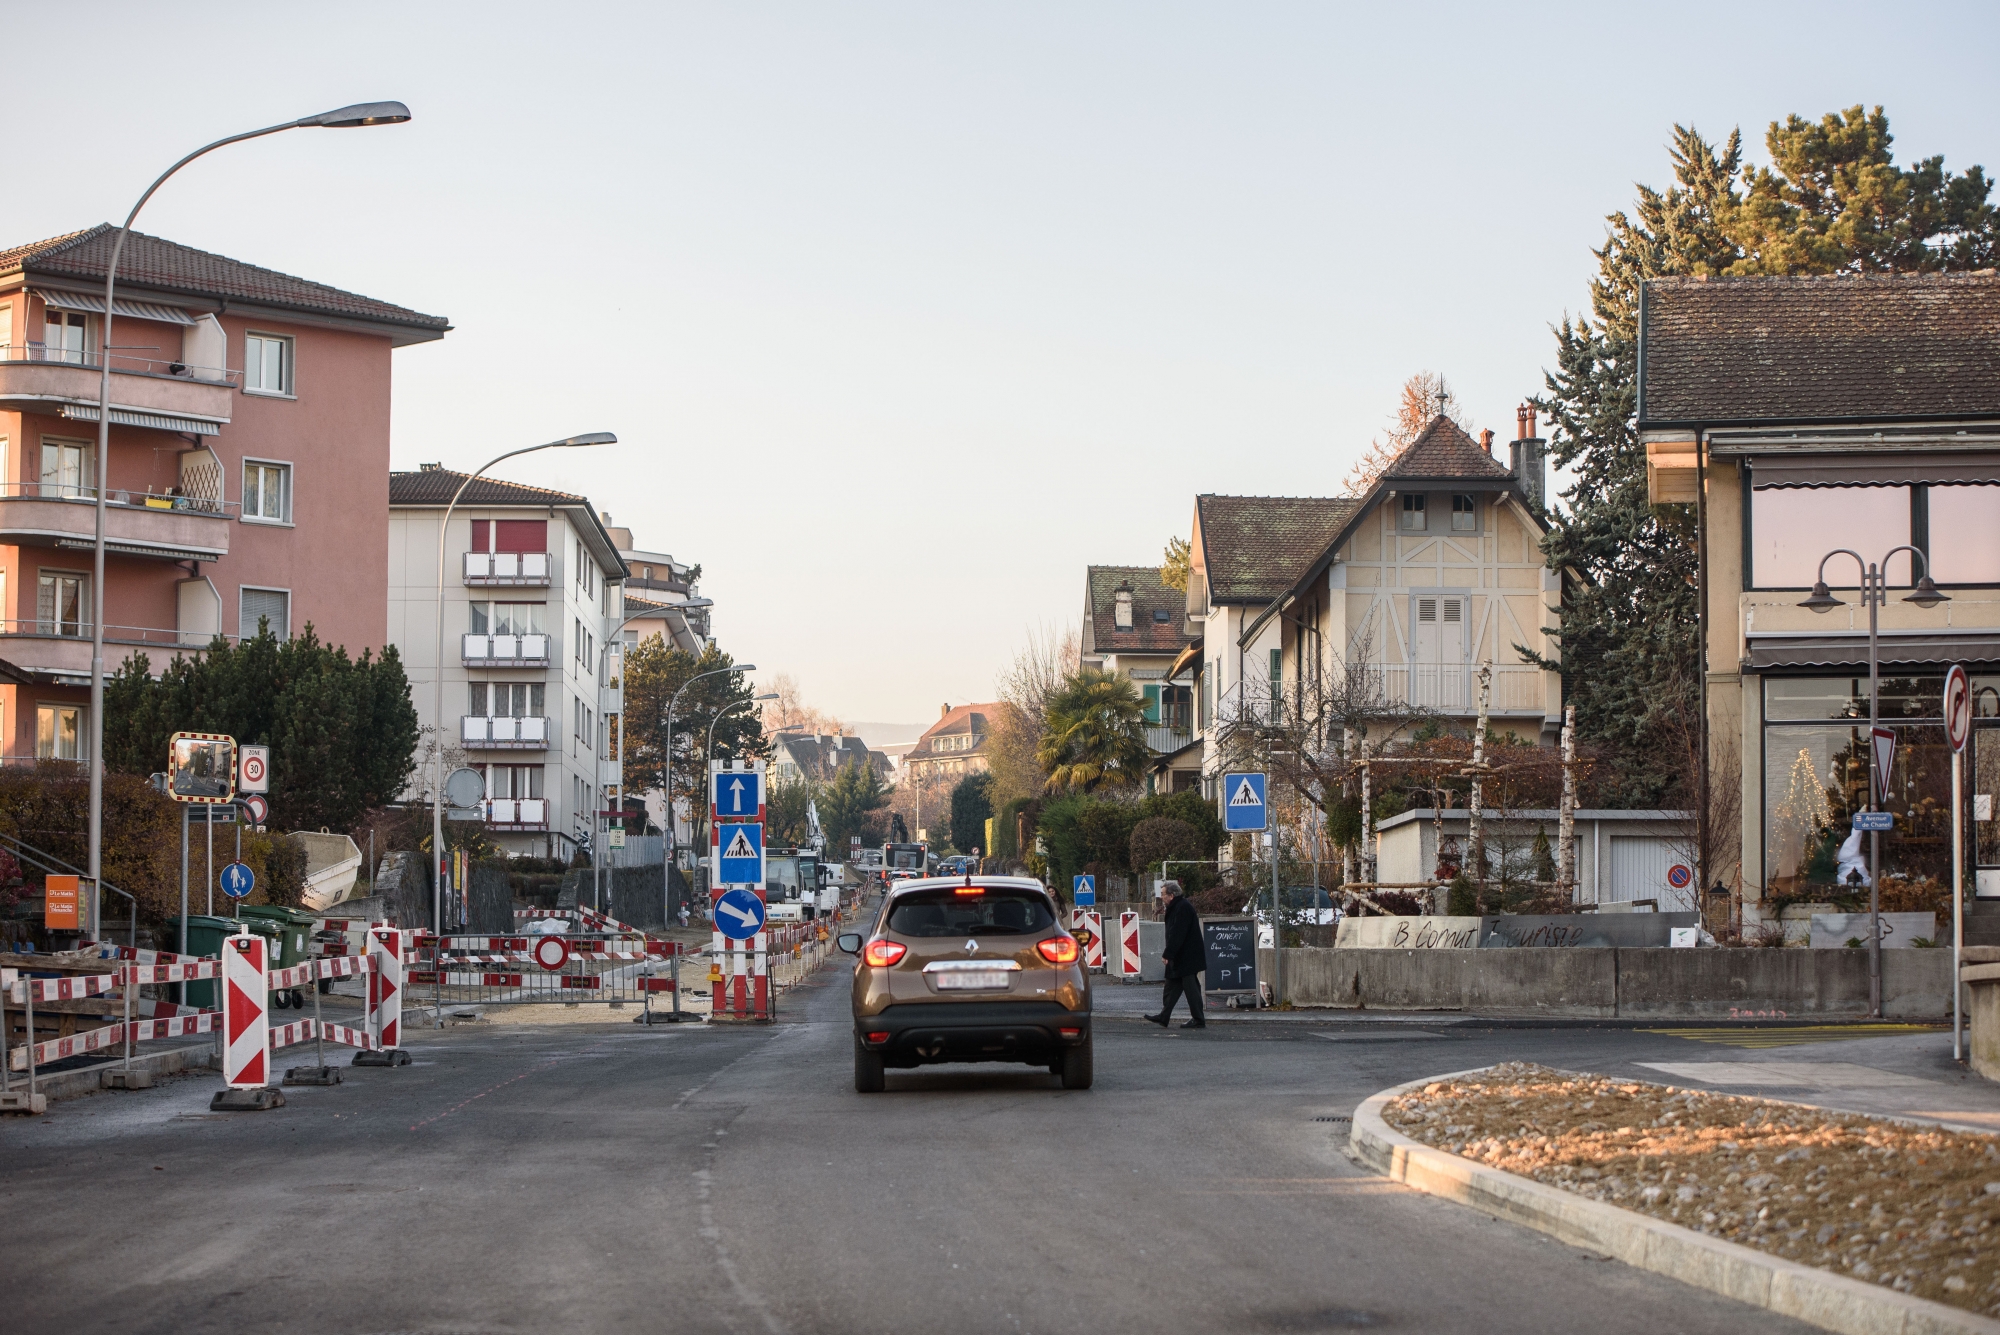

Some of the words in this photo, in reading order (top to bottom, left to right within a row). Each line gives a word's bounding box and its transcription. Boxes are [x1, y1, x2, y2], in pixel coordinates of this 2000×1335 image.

[249, 764, 259, 774] 30
[1215, 932, 1243, 941] OUVERT
[1221, 969, 1232, 981] P
